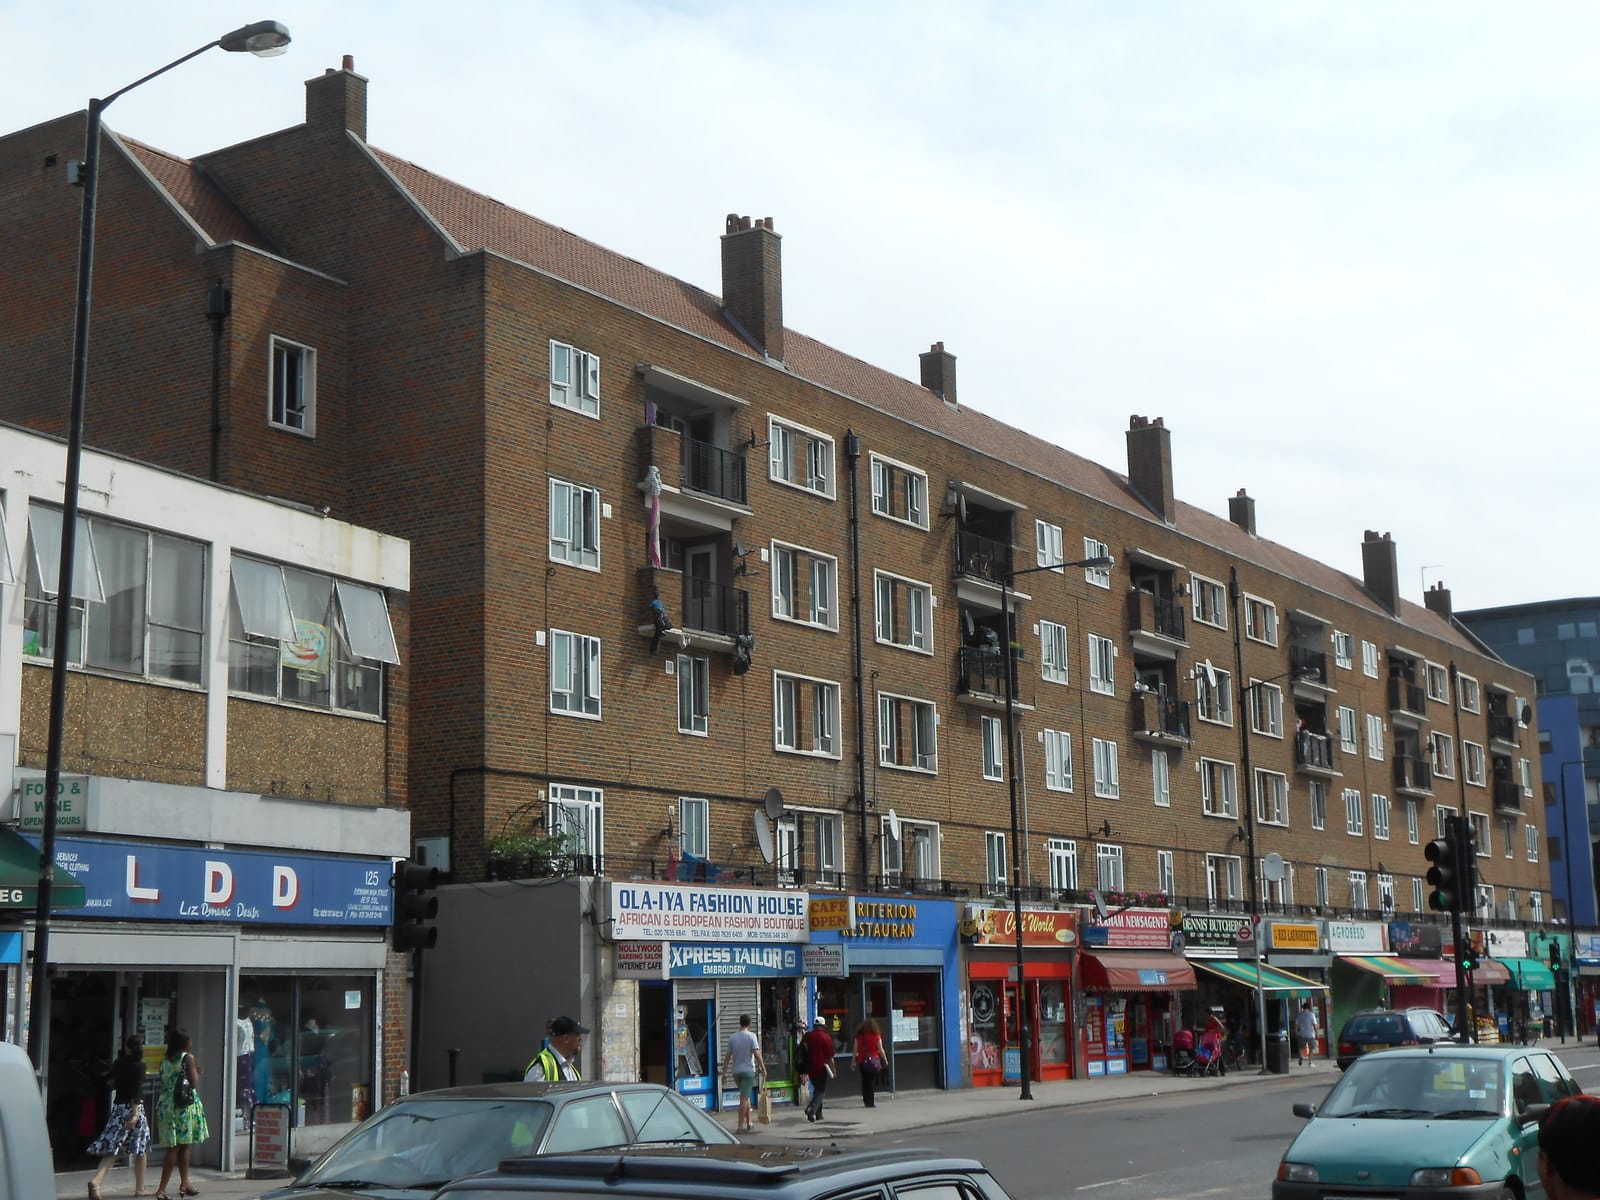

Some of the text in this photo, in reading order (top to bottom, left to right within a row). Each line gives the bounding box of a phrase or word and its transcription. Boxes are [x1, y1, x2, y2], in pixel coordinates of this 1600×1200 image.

[25, 782, 80, 795] FOD &
[34, 801, 72, 812] WNE
[126, 855, 299, 908] L D D
[365, 870, 379, 886] 125
[619, 889, 804, 916] OLA-IYA FASHION HOUSE
[810, 901, 848, 913] CAFE
[857, 902, 917, 919] RITERION
[619, 912, 805, 930] AFRICAN & EUROPEAN FASHION BOUTIQUE
[811, 916, 847, 928] OPEN
[1027, 913, 1055, 932] World
[1126, 915, 1168, 928] NEWSAGENTS
[1183, 918, 1208, 931] DENNIS
[669, 946, 782, 970] XPRESS TAILOR
[617, 961, 646, 970] INTERNET
[703, 965, 746, 974] EMBROIDERY
